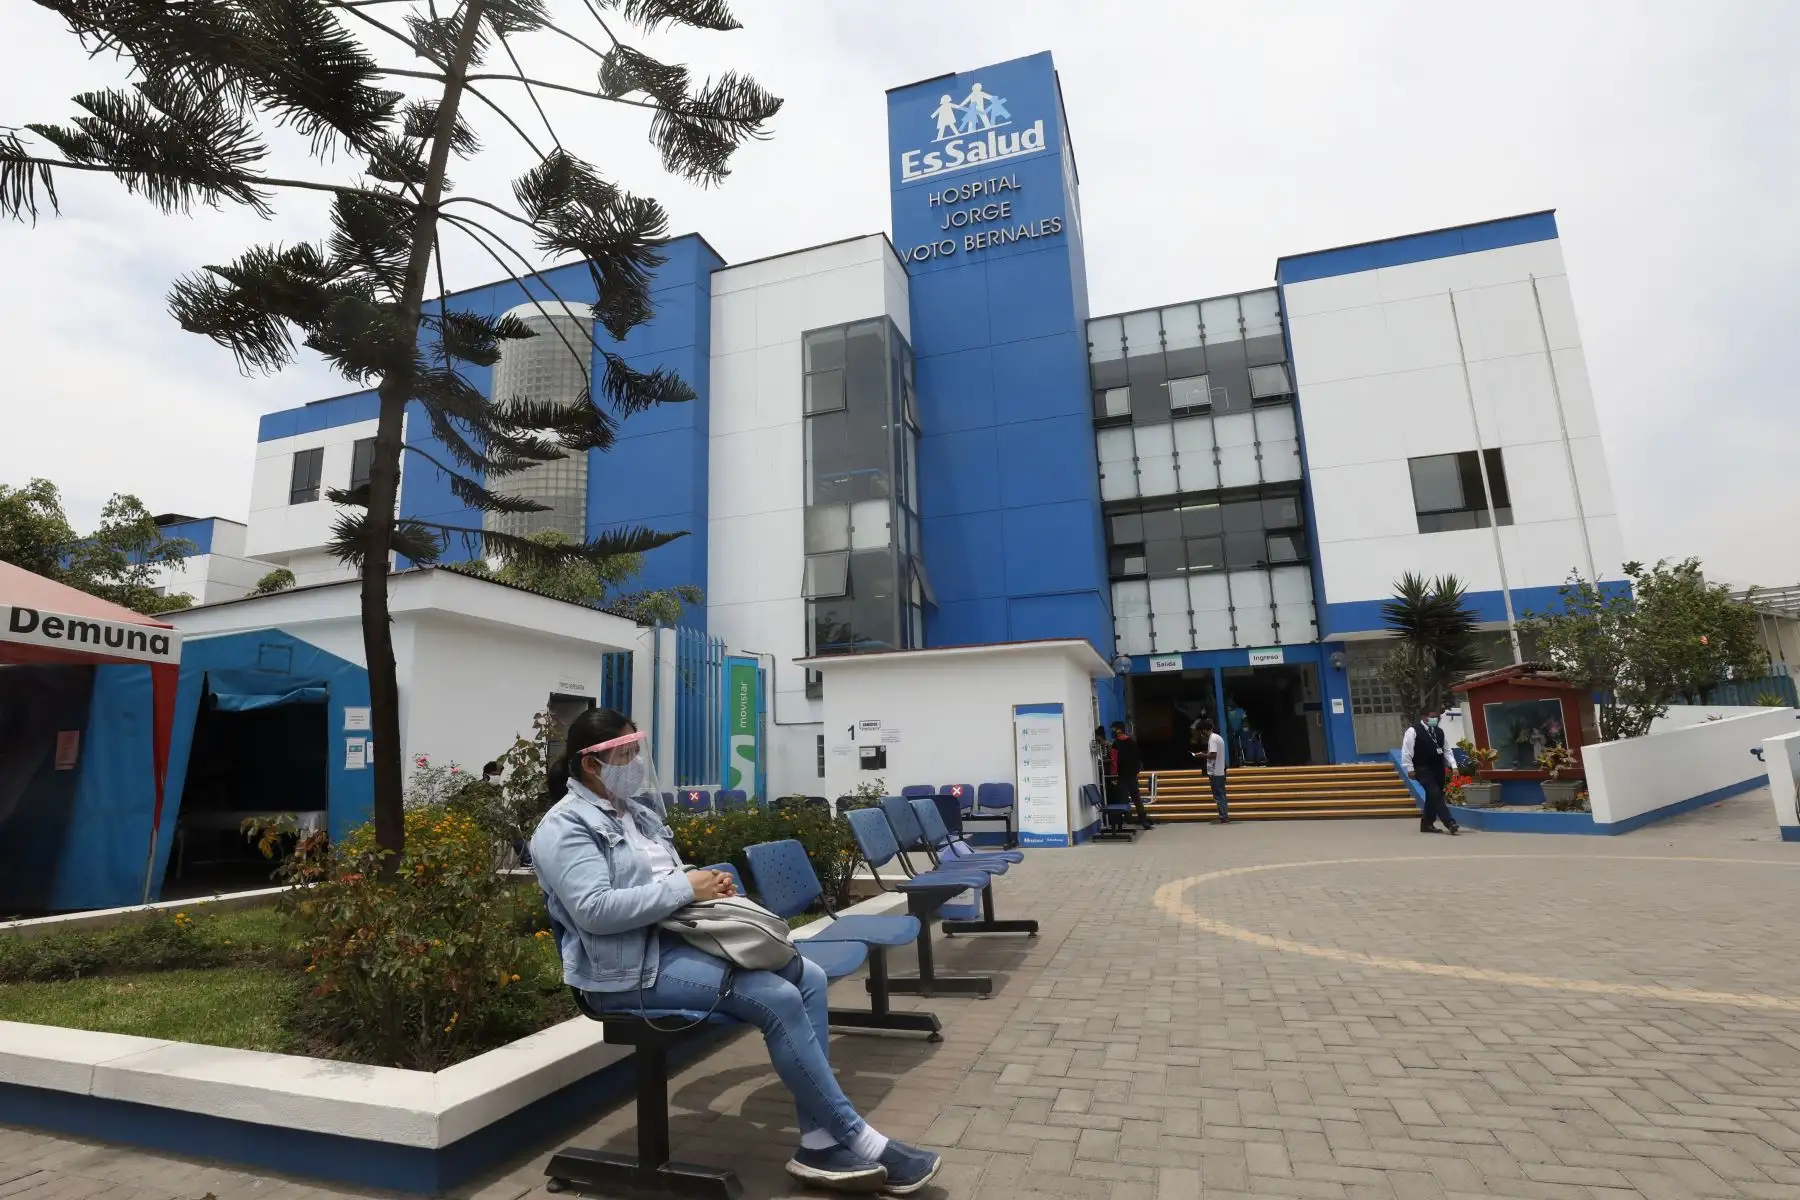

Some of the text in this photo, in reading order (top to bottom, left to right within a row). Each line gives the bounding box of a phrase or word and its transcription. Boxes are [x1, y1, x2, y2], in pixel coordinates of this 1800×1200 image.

[901, 119, 1045, 179] EsSalud
[929, 173, 1022, 208] HOSPITAL
[941, 201, 1011, 230] JORGE
[901, 216, 1062, 264] VOTO BERNALES
[9, 606, 170, 655] Demuna
[1156, 660, 1176, 668] Salida
[1253, 654, 1279, 662] Ingreso
[740, 681, 748, 728] movistar
[847, 725, 855, 741] 1
